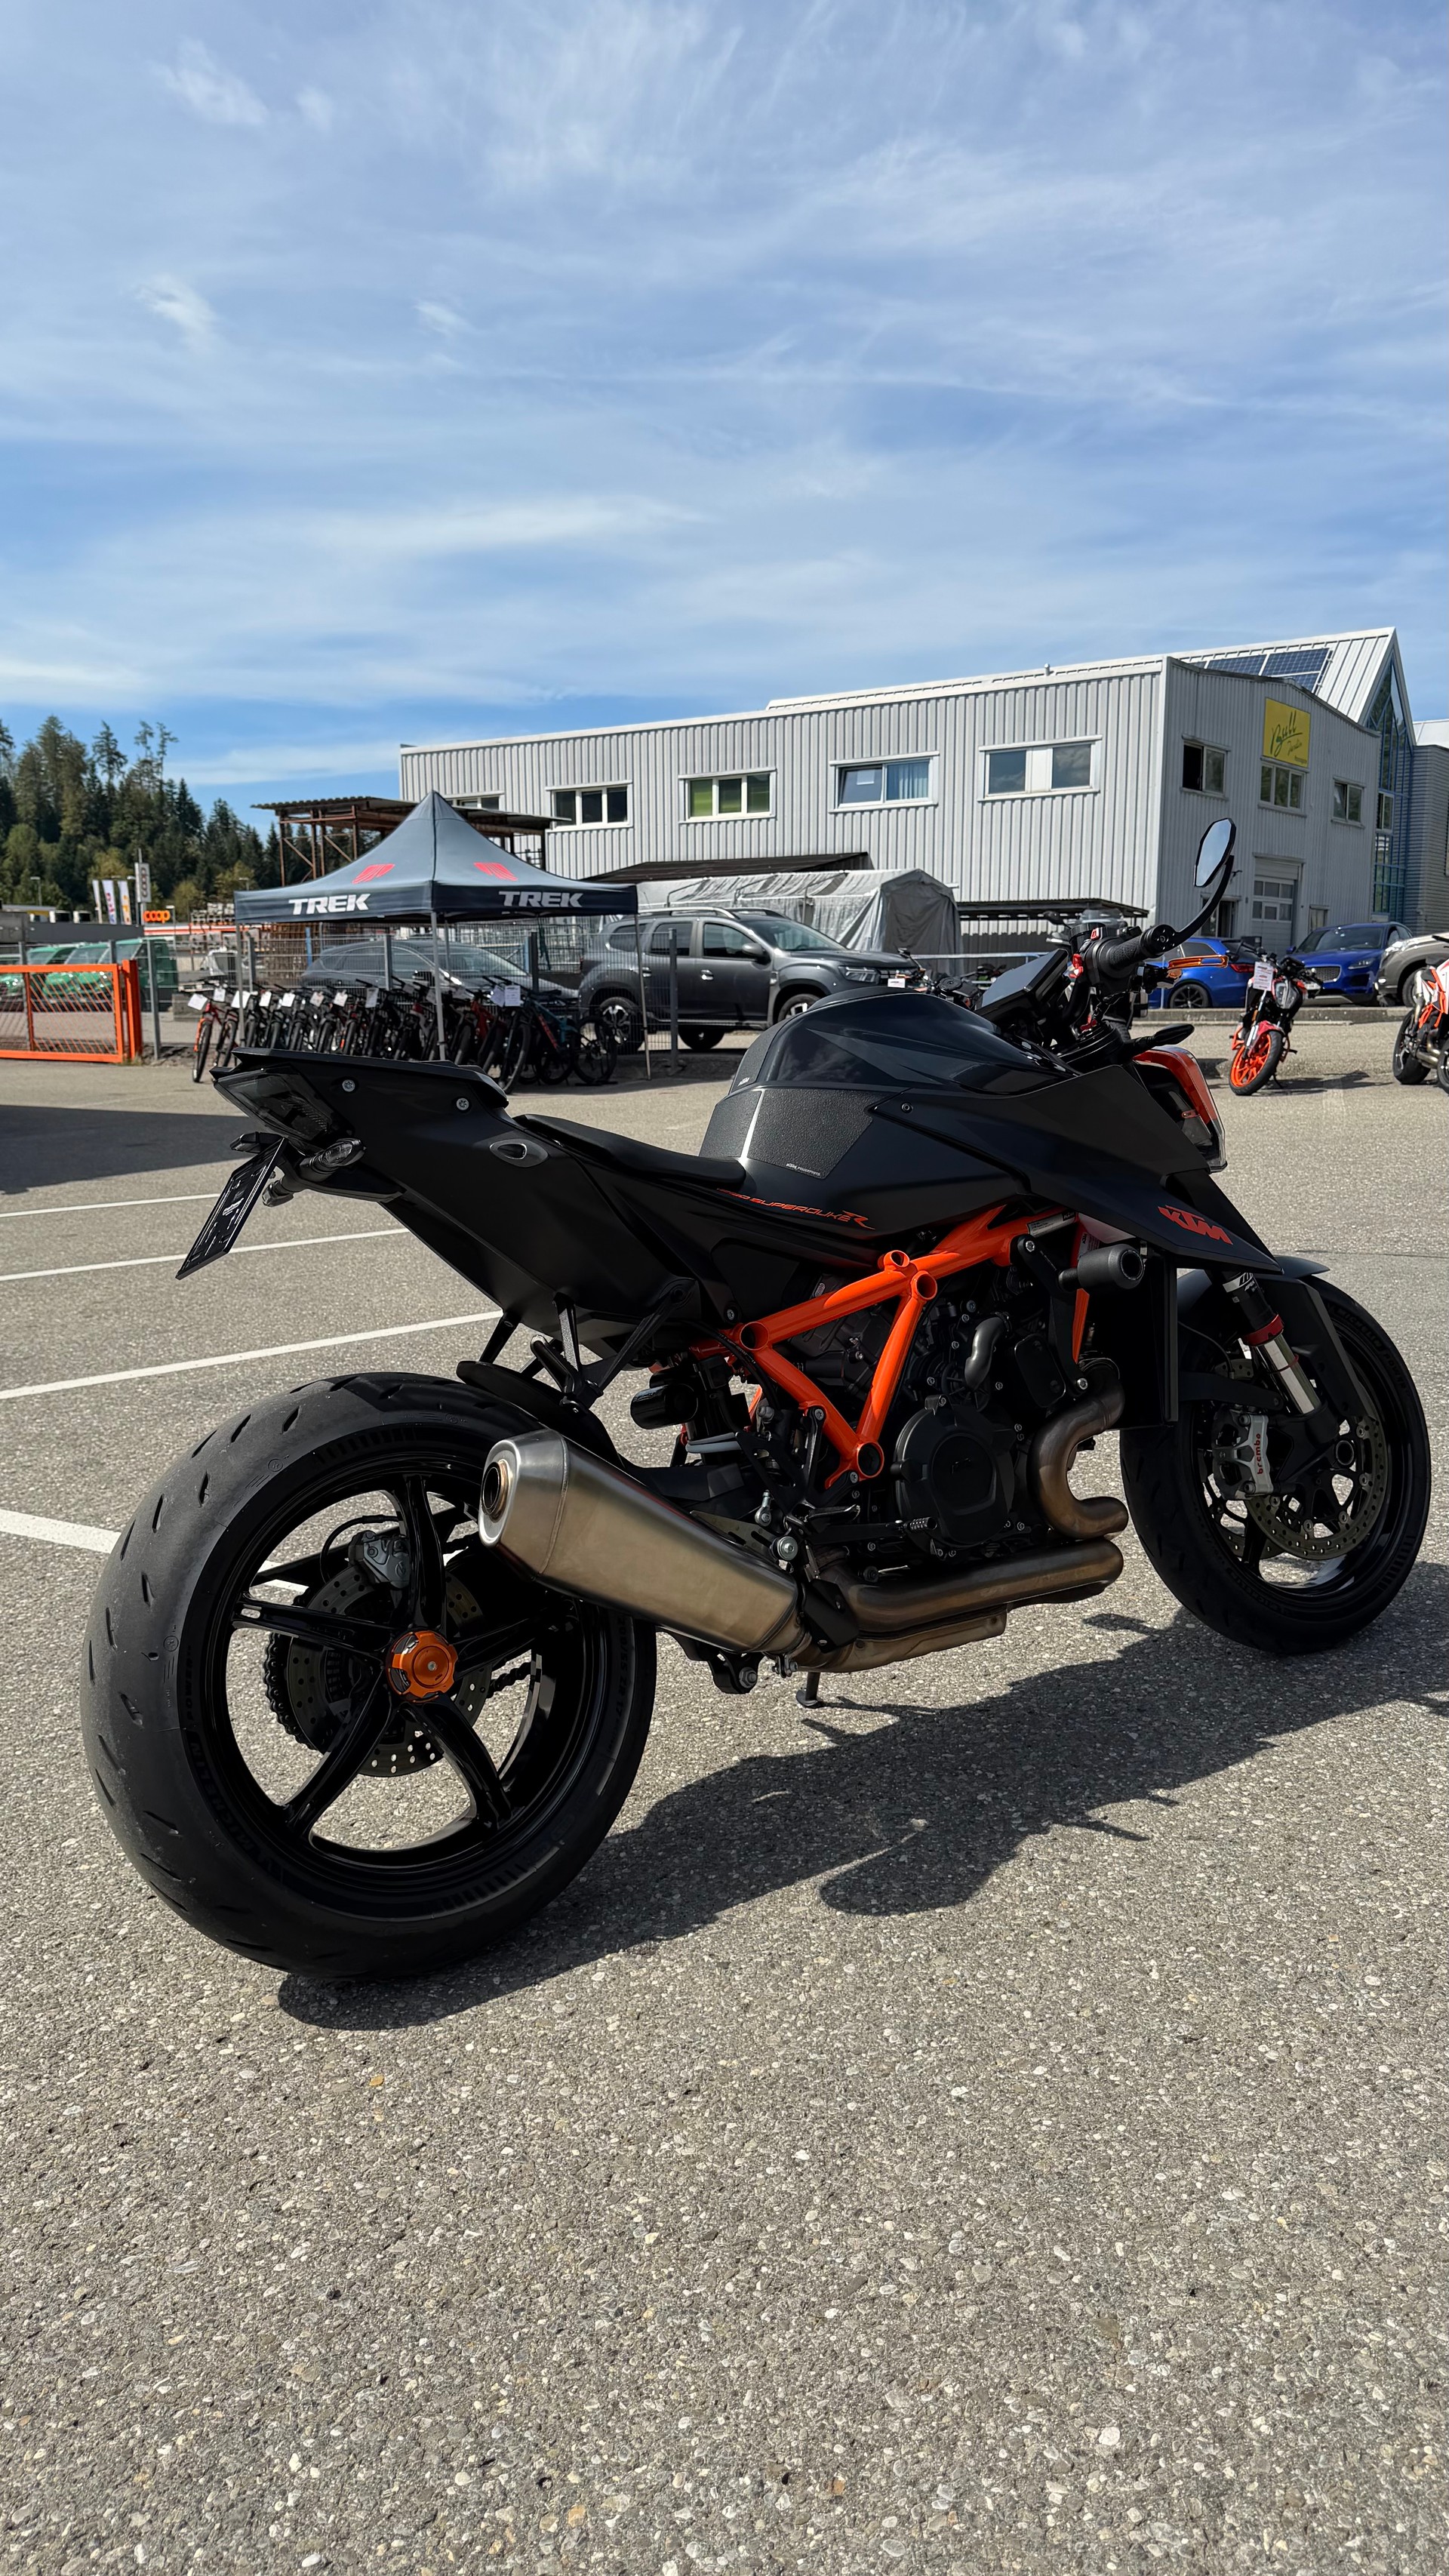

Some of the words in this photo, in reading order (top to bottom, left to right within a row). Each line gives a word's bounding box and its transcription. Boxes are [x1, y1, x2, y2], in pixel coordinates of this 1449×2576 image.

[288, 894, 371, 915] TREK
[498, 891, 583, 907] TREK
[143, 909, 171, 924] coop
[842, 1210, 875, 1230] R
[1158, 1205, 1233, 1245] KTM
[1254, 1433, 1263, 1474] brembo
